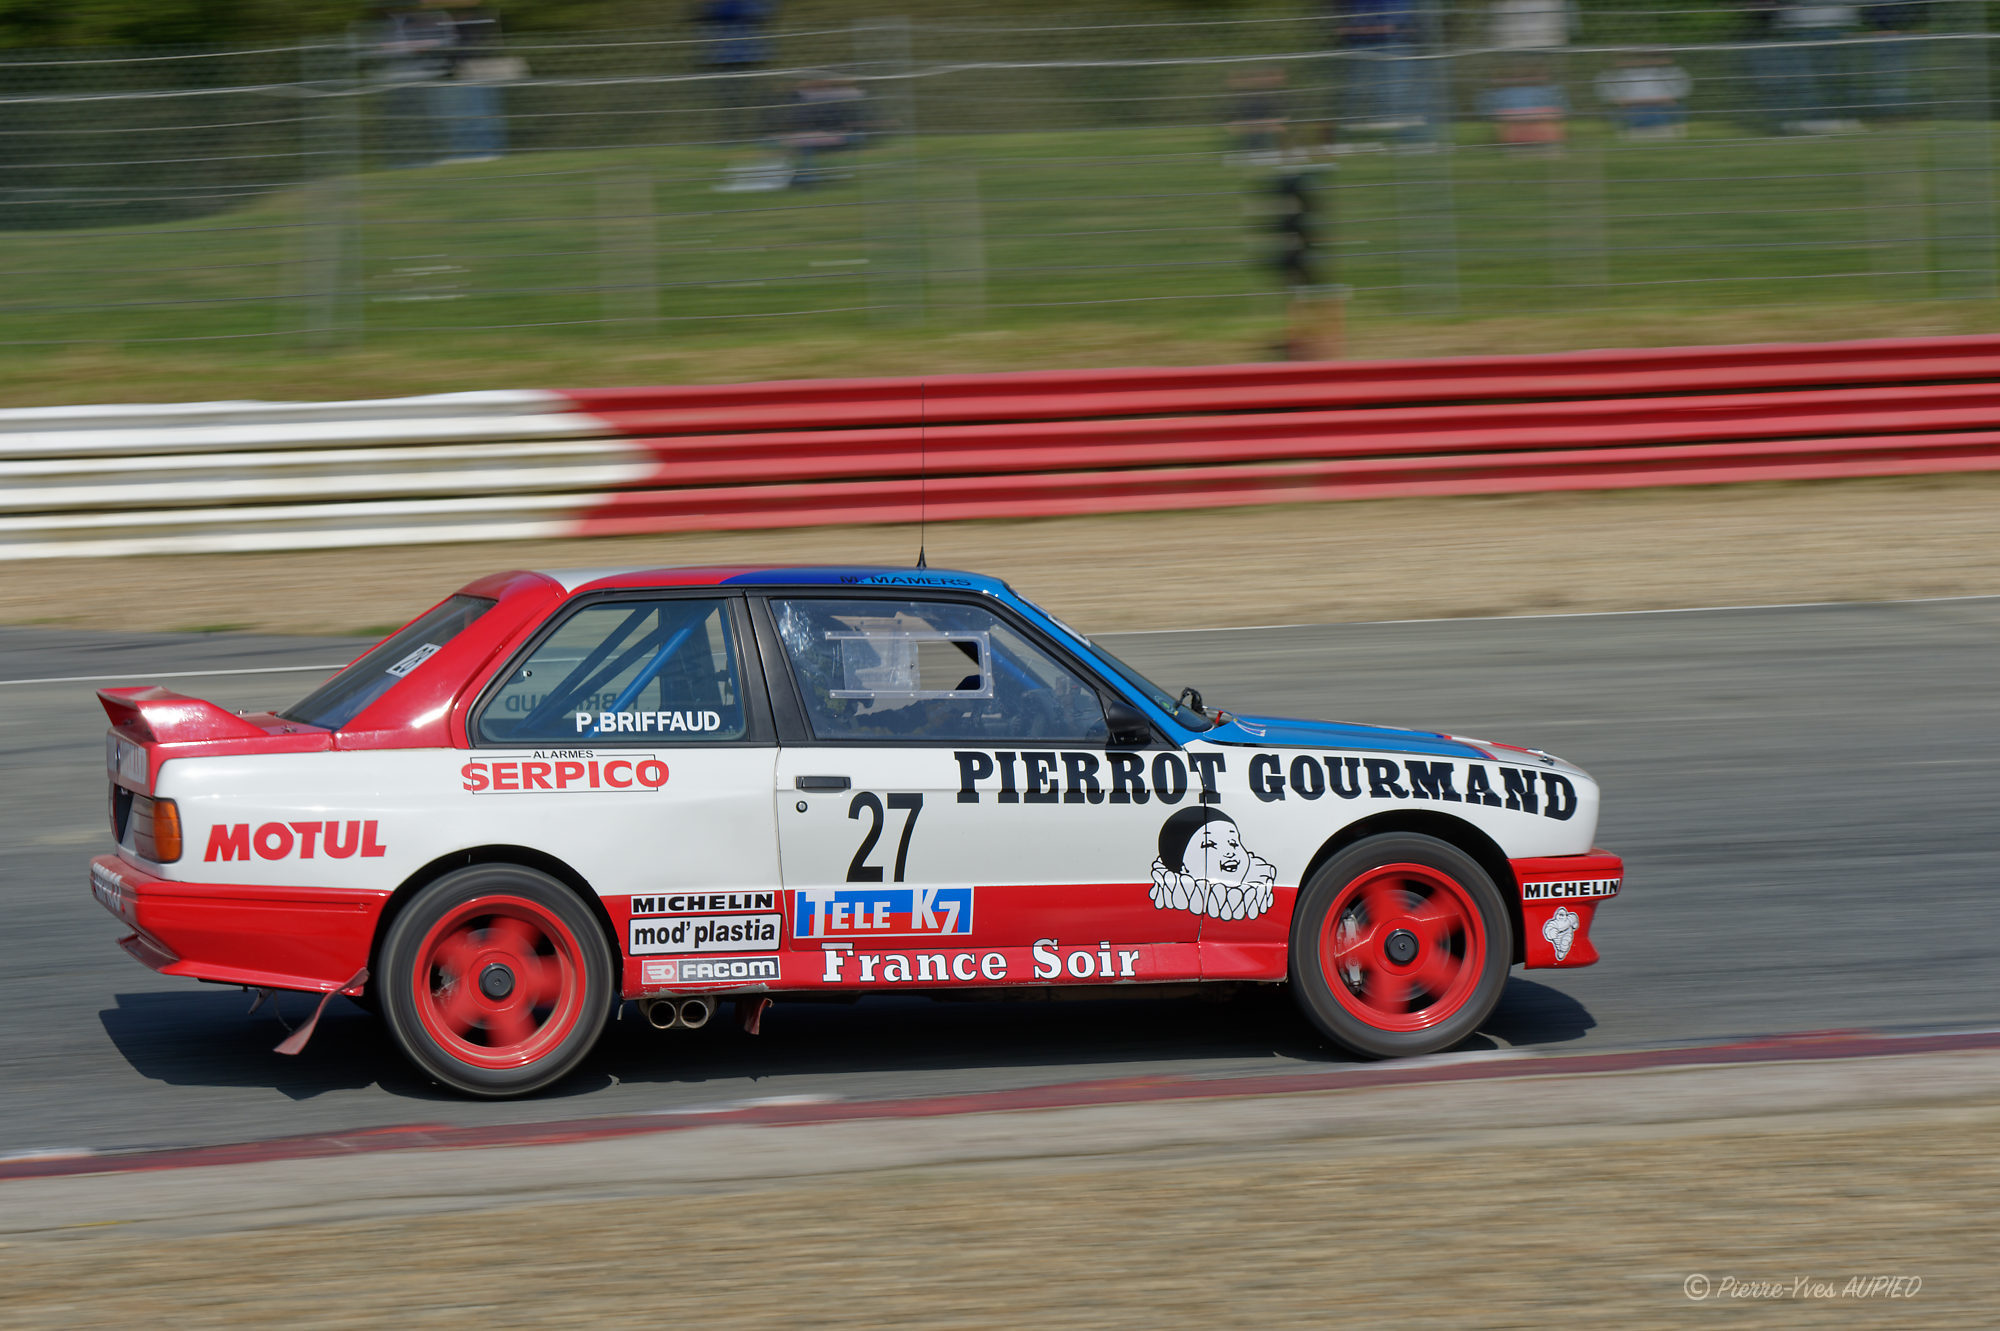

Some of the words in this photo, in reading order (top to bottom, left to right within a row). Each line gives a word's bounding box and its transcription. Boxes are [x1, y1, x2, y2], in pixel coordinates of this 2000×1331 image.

[870, 576, 971, 586] MAMERS
[576, 711, 721, 732] P.BRIFFAUD
[533, 750, 594, 759] ALARMES
[461, 759, 670, 791] SERPICO
[953, 751, 1227, 805] PIERROT
[1249, 753, 1578, 821] GOURMAND
[203, 820, 387, 862] MOTUL
[846, 792, 924, 883] 27
[632, 893, 774, 913] MICHELIN
[1524, 880, 1619, 899] MICHELIN
[805, 890, 891, 937] TELE
[911, 888, 961, 935] K7
[694, 918, 775, 949] plastia
[820, 942, 1008, 982] France
[1032, 937, 1140, 979] Soir
